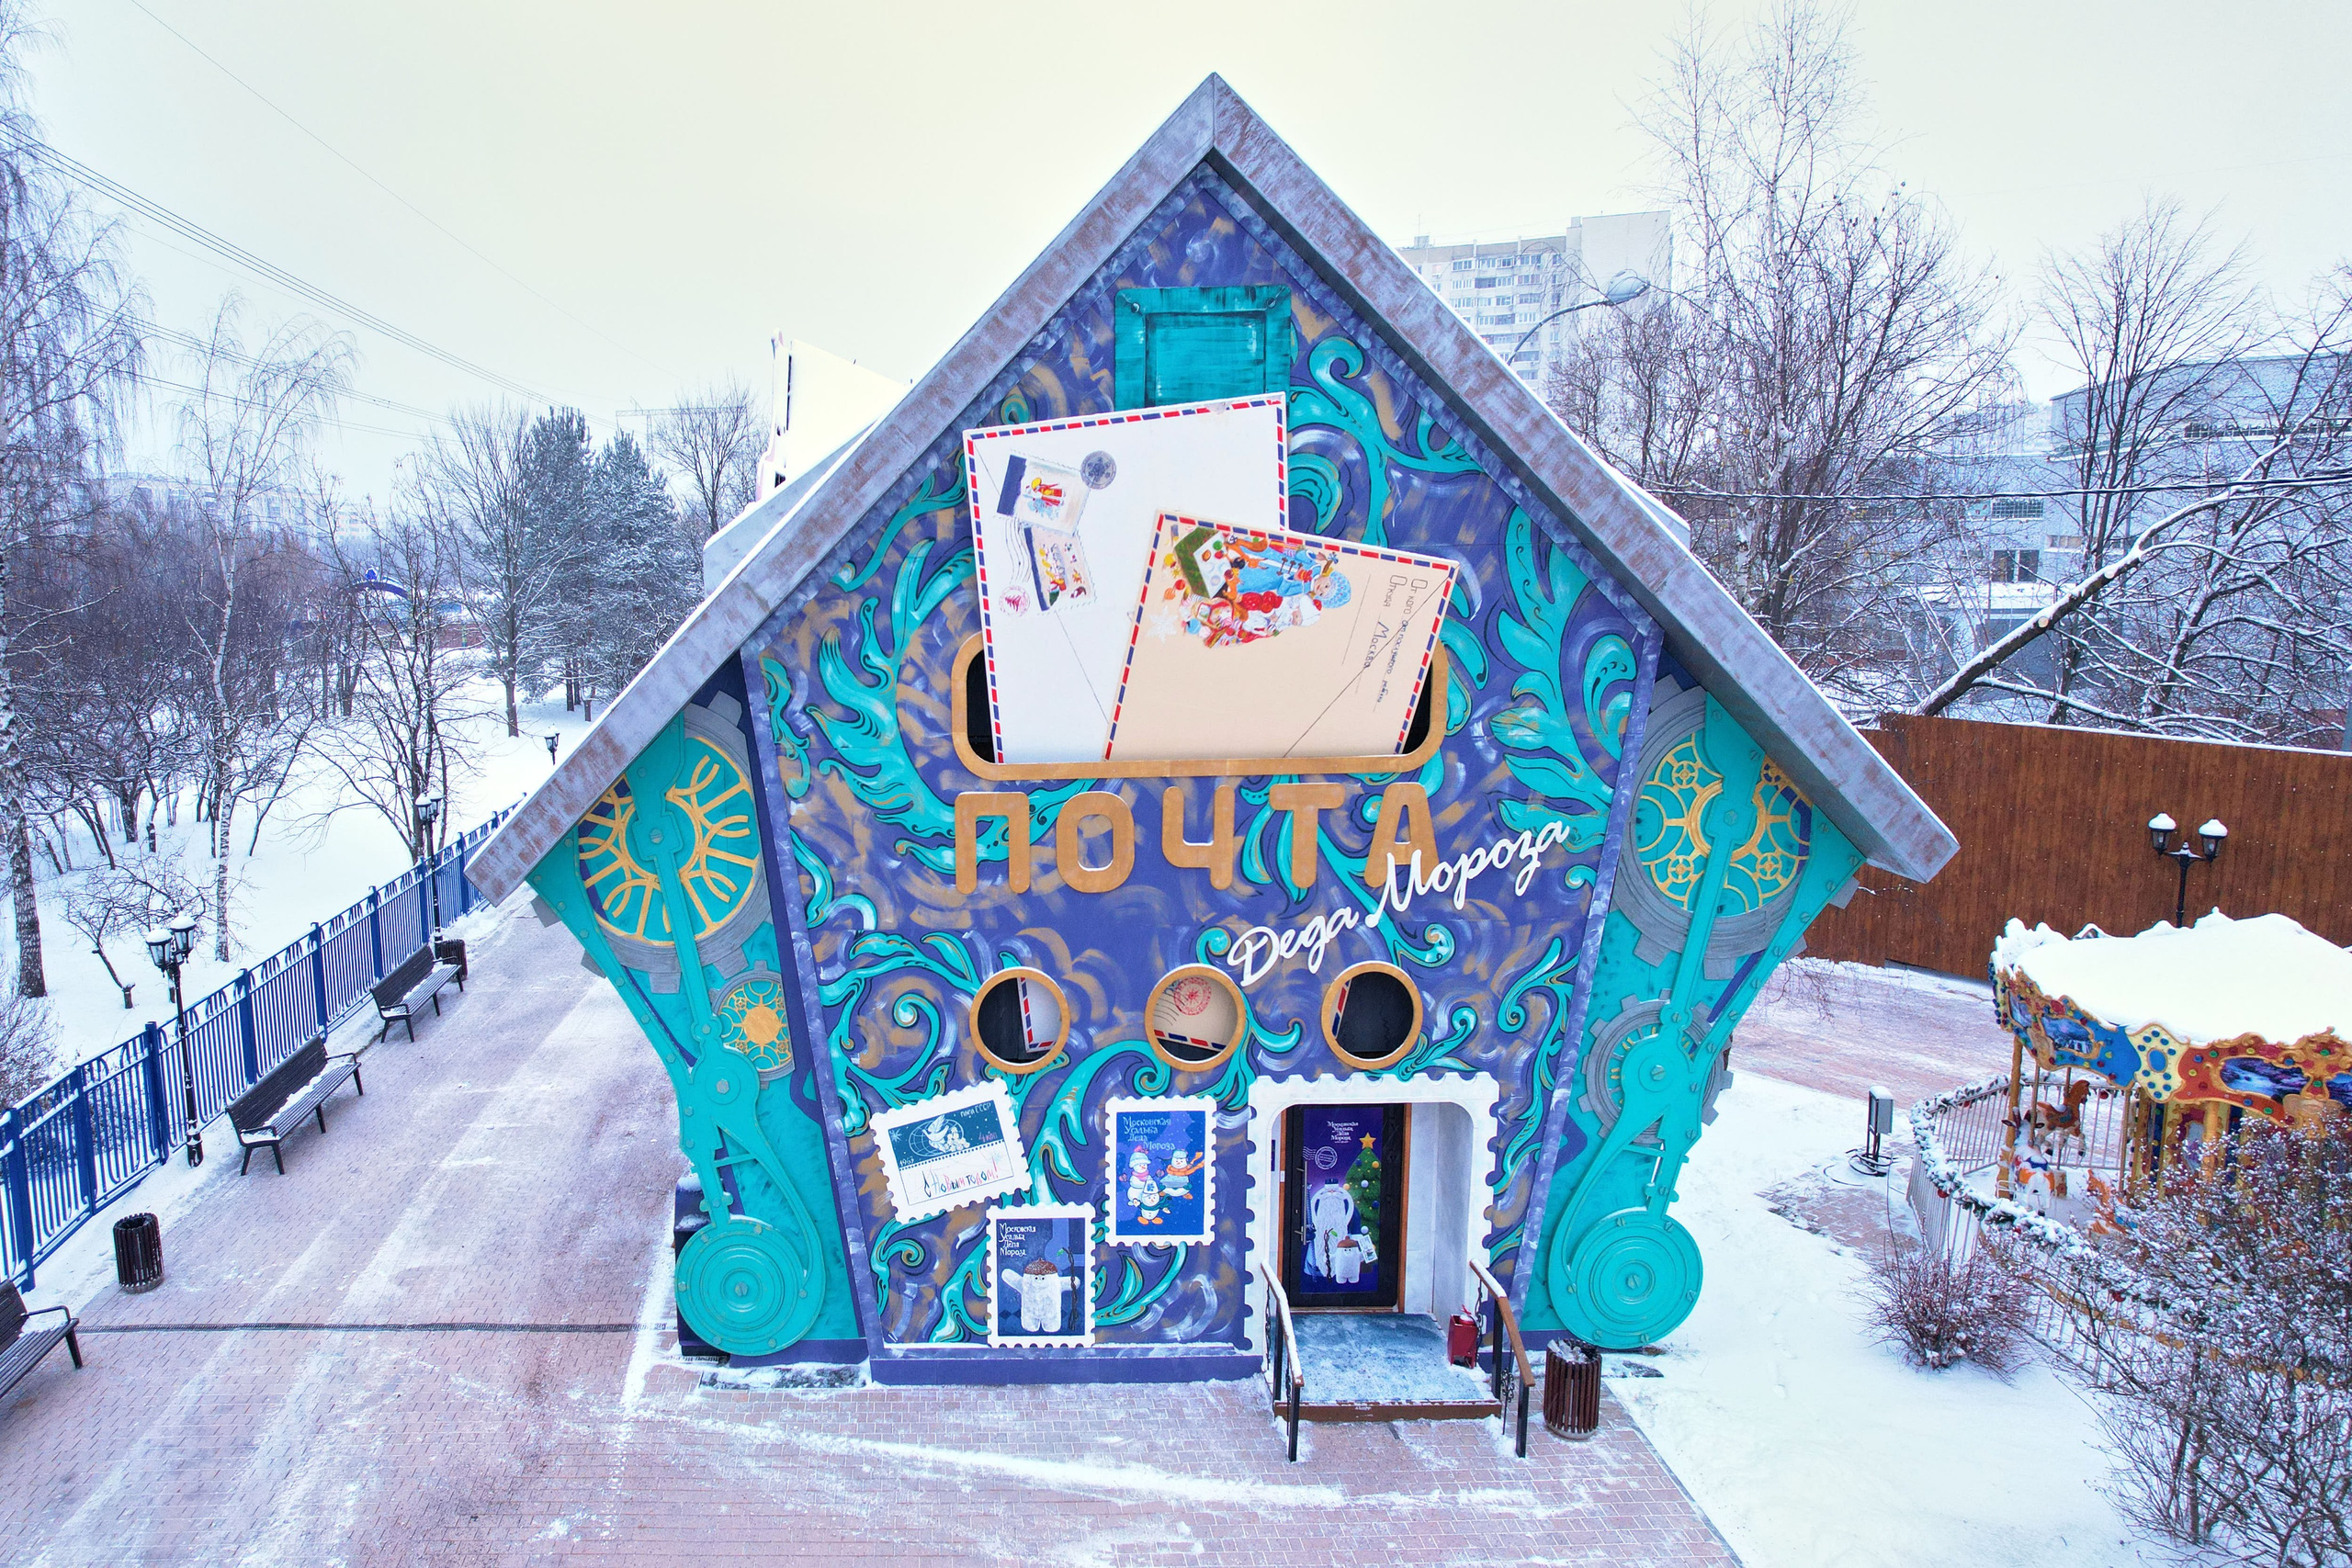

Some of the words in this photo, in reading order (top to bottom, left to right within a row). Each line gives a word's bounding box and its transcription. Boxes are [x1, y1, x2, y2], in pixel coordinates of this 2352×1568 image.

[1363, 621, 1389, 668] Москва
[955, 782, 1440, 894] ПОЧТА
[1227, 904, 1358, 987] Деда
[1365, 819, 1570, 928] Мороза
[1123, 1116, 1172, 1127] Московская
[1143, 1141, 1175, 1151] Мороза
